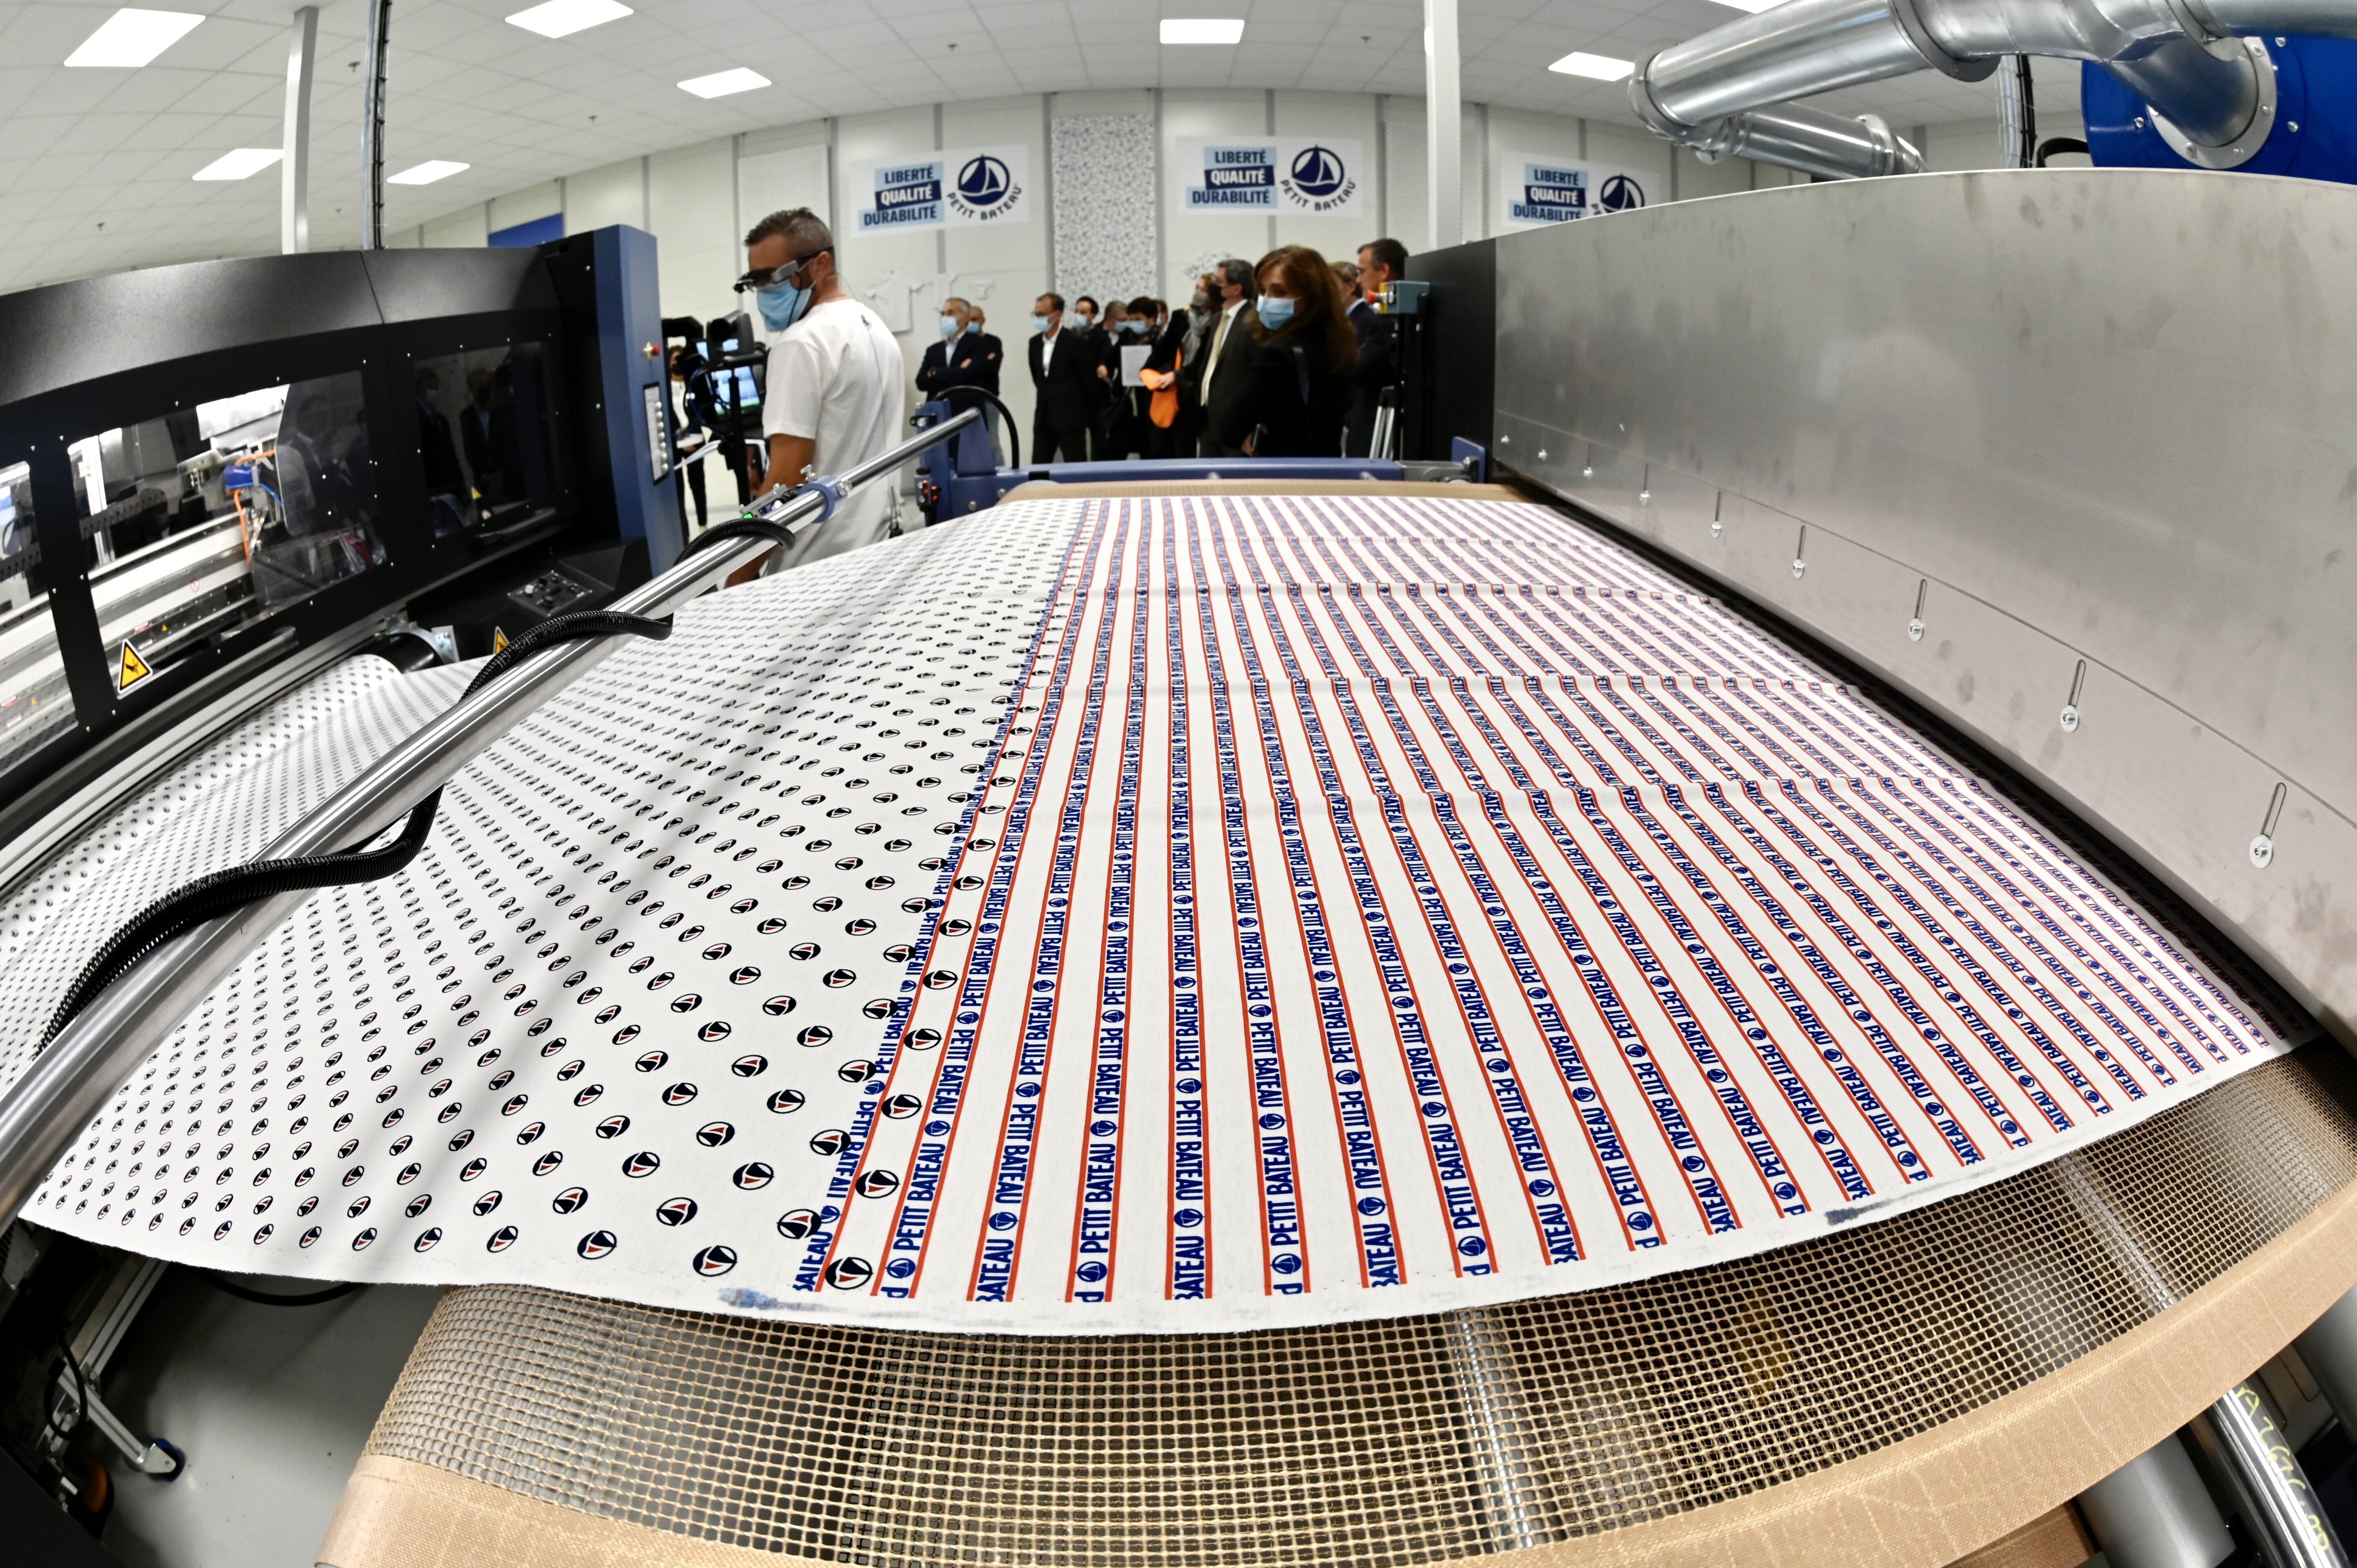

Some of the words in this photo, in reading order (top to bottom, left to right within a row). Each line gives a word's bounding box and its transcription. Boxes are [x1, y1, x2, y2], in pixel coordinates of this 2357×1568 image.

[885, 165, 934, 184] LIBERTÉ
[1214, 149, 1266, 164] LIBERTÉ
[881, 184, 933, 206] QUALITÉ
[1211, 168, 1266, 185] QUALITÉ
[1280, 179, 1310, 208] PETIT
[1314, 181, 1356, 211] BATEAU
[1535, 169, 1578, 185] LIBERTÉ
[947, 192, 975, 218] PETIT
[981, 186, 1022, 220] BATEAU
[1192, 190, 1270, 204] DURABILITÉ
[1530, 187, 1578, 204] QUALITÉ
[864, 205, 937, 226] DURABILITÉ
[1828, 869, 1853, 887] PETIT
[1849, 889, 1882, 917] BATEAU
[1892, 885, 1921, 912] BATEAU
[1905, 861, 1928, 878] PETIT
[1926, 880, 1958, 907] BATEAU
[1173, 908, 1194, 932] PETIT
[1301, 903, 1324, 927] PETIT
[1423, 898, 1449, 921] PETIT
[1538, 892, 1566, 915] PETIT
[1553, 916, 1586, 951] BATEAU
[1645, 885, 1672, 907] PETIT
[1662, 908, 1696, 941] BATEAU
[1715, 903, 1748, 935] BATEAU
[1741, 877, 1768, 898] PETIT
[1760, 898, 1793, 930] BATEAU
[1810, 895, 1840, 923] BATEAU
[1044, 911, 1065, 936] PETIT
[1433, 923, 1464, 959] BATEAU
[1494, 920, 1527, 955] BATEAU
[1610, 912, 1643, 946] BATEAU
[1833, 925, 1862, 947] PETIT
[1917, 913, 1943, 934] PETIT
[1967, 921, 2003, 950] BATEAU
[2033, 910, 2066, 938] BATEAU
[969, 937, 997, 975] BATEAU
[1037, 937, 1062, 976] BATEAU
[1106, 936, 1128, 974] BATEAU
[1174, 934, 1196, 972] BATEAU
[1241, 931, 1265, 970] BATEAU
[1306, 929, 1333, 966] BATEAU
[1371, 925, 1400, 962] BATEAU
[1631, 948, 1661, 973] PETIT
[1738, 936, 1768, 961] PETIT
[1889, 932, 1927, 964] BATEAU
[1997, 951, 2024, 972] PETIT
[2022, 935, 2048, 956] PETIT
[2045, 957, 2081, 988] BATEAU
[2063, 938, 2088, 958] PETIT
[2084, 924, 2106, 943] PETIT
[2106, 944, 2137, 973] BATEAU
[1382, 965, 1410, 993] PETIT
[1512, 957, 1541, 984] PETIT
[1698, 957, 1736, 995] BATEAU
[1801, 945, 1837, 980] BATEAU
[1919, 965, 1949, 989] PETIT
[1951, 948, 1979, 969] PETIT
[1974, 971, 2012, 1006] BATEAU
[961, 977, 987, 1007] PETIT
[1103, 976, 1126, 1006] PETIT
[1245, 972, 1269, 1001] PETIT
[1455, 978, 1489, 1020] BATEAU
[1582, 969, 1620, 1008] BATEAU
[1828, 980, 1860, 1006] PETIT
[1866, 962, 1897, 986] PETIT
[1889, 987, 1930, 1025] BATEAU
[2099, 972, 2125, 993] PETIT
[2122, 993, 2158, 1026] BATEAU
[2151, 986, 2183, 1017] BATEAU
[1026, 996, 1054, 1041] BATEAU
[1176, 993, 1199, 1037] BATEAU
[1318, 986, 1348, 1030] BATEAU
[1534, 1002, 1566, 1033] PETIT
[1604, 1009, 1637, 1039] PETIT
[1723, 995, 1756, 1024] PETIT
[1770, 977, 1802, 1002] PETIT
[1791, 1004, 1833, 1046] BATEAU
[2034, 988, 2063, 1011] PETIT
[2058, 1012, 2097, 1047] BATEAU
[2091, 1002, 2129, 1036] BATEAU
[947, 1028, 976, 1062] PETIT
[1099, 1027, 1124, 1060] PETIT
[1251, 1021, 1277, 1054] PETIT
[1397, 1012, 1426, 1044] PETIT
[1471, 1021, 1503, 1053] PETIT
[1659, 990, 1691, 1018] PETIT
[1678, 1021, 1719, 1065] BATEAU
[1957, 1005, 1988, 1032] PETIT
[1981, 1032, 2023, 1072] BATEAU
[2021, 1021, 2062, 1059] BATEAU
[2182, 1019, 2207, 1041] PETIT
[1019, 1042, 1047, 1076] PETIT
[1176, 1039, 1200, 1072] PETIT
[1326, 1030, 1356, 1064] PETIT
[1549, 1035, 1589, 1082] BATEAU
[1865, 1024, 1899, 1054] PETIT
[1888, 1055, 1933, 1099] BATEAU
[1936, 1043, 1980, 1085] BATEAU
[2126, 1037, 2154, 1062] PETIT
[931, 1064, 967, 1115] BATEAU
[1093, 1063, 1122, 1115] BATEAU
[1254, 1057, 1283, 1108] BATEAU
[1406, 1047, 1442, 1097] BATEAU
[1757, 1044, 1792, 1075] PETIT
[1779, 1077, 1824, 1125] BATEAU
[1836, 1065, 1880, 1112] BATEAU
[2056, 1060, 2088, 1088] PETIT
[1339, 1090, 1370, 1127] PETIT
[1492, 1077, 1527, 1113] PETIT
[1633, 1062, 1669, 1095] PETIT
[1652, 1097, 1697, 1150] BATEAU
[1718, 1087, 1763, 1138] BATEAU
[1971, 1086, 2006, 1118] PETIT
[1007, 1103, 1037, 1142] PETIT
[1176, 1099, 1202, 1138] PETIT
[1582, 1107, 1625, 1162] BATEAU
[1869, 1113, 1907, 1148] PETIT
[1347, 1130, 1382, 1190] BATEAU
[1427, 1123, 1467, 1181] BATEAU
[1507, 1116, 1548, 1173] BATEAU
[1748, 1140, 1786, 1178] PETIT
[907, 1142, 946, 1202] BATEAU
[995, 1144, 1031, 1205] BATEAU
[1085, 1143, 1116, 1203] BATEAU
[1175, 1140, 1204, 1201] BATEAU
[1262, 1135, 1294, 1196] BATEAU
[1606, 1165, 1645, 1207] PETIT
[1268, 1200, 1299, 1247] PETIT
[1444, 1185, 1481, 1230] PETIT
[893, 1205, 930, 1252] PETIT
[1080, 1207, 1111, 1254] PETIT
